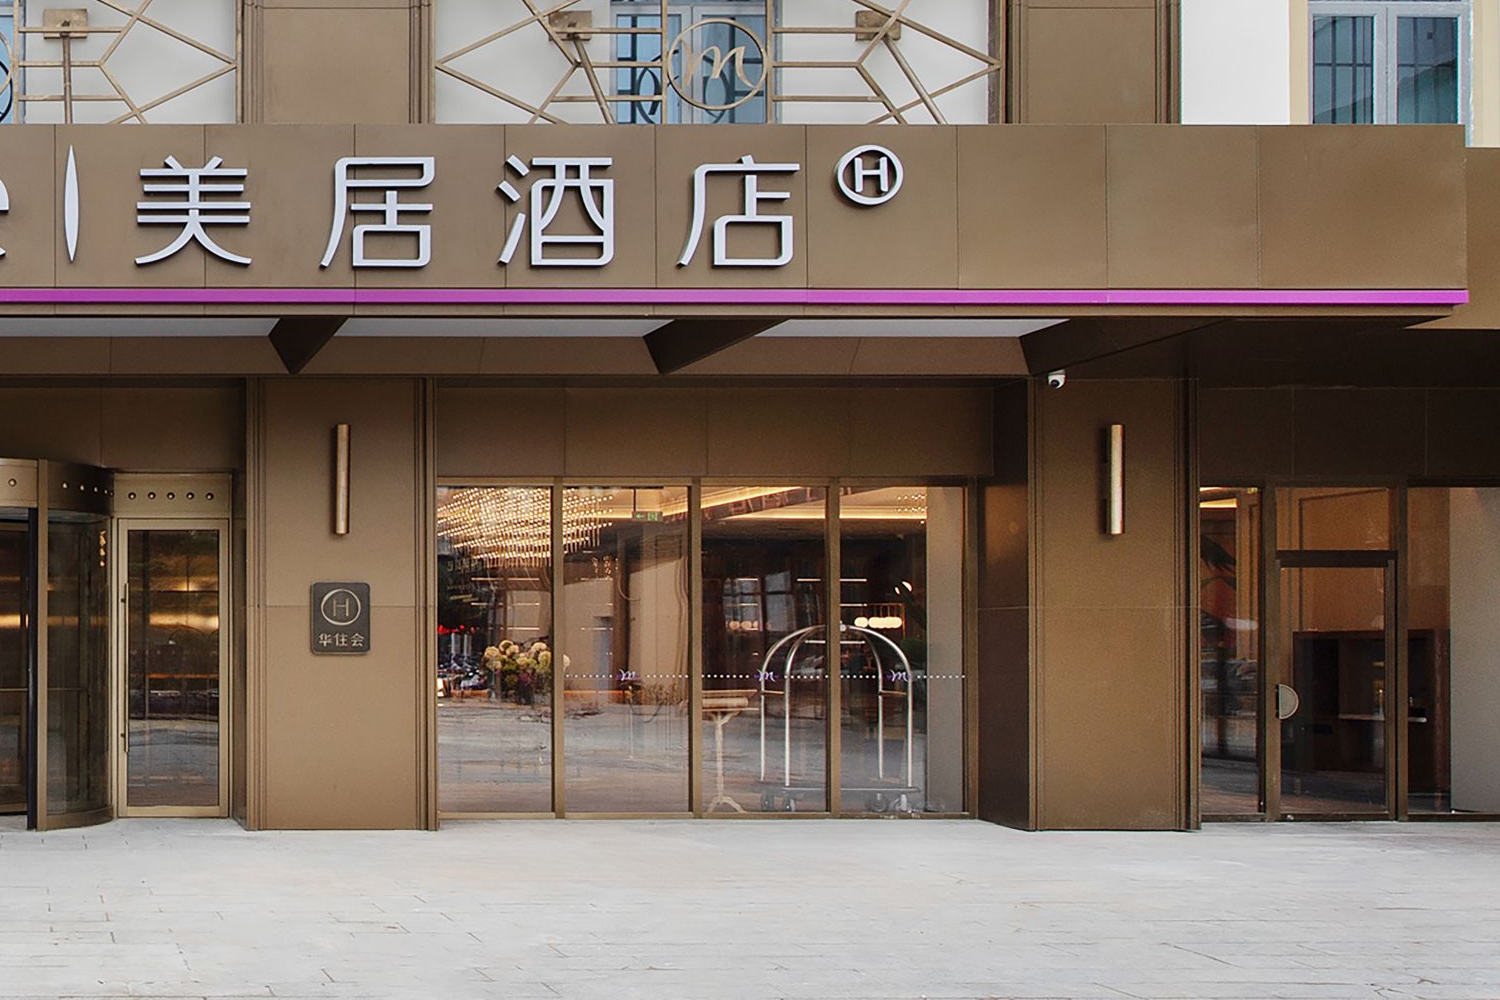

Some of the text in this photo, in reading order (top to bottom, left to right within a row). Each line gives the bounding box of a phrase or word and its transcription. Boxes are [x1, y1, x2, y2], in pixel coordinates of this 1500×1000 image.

[133, 153, 802, 268] 美居酒店
[318, 632, 365, 648] 华住会
